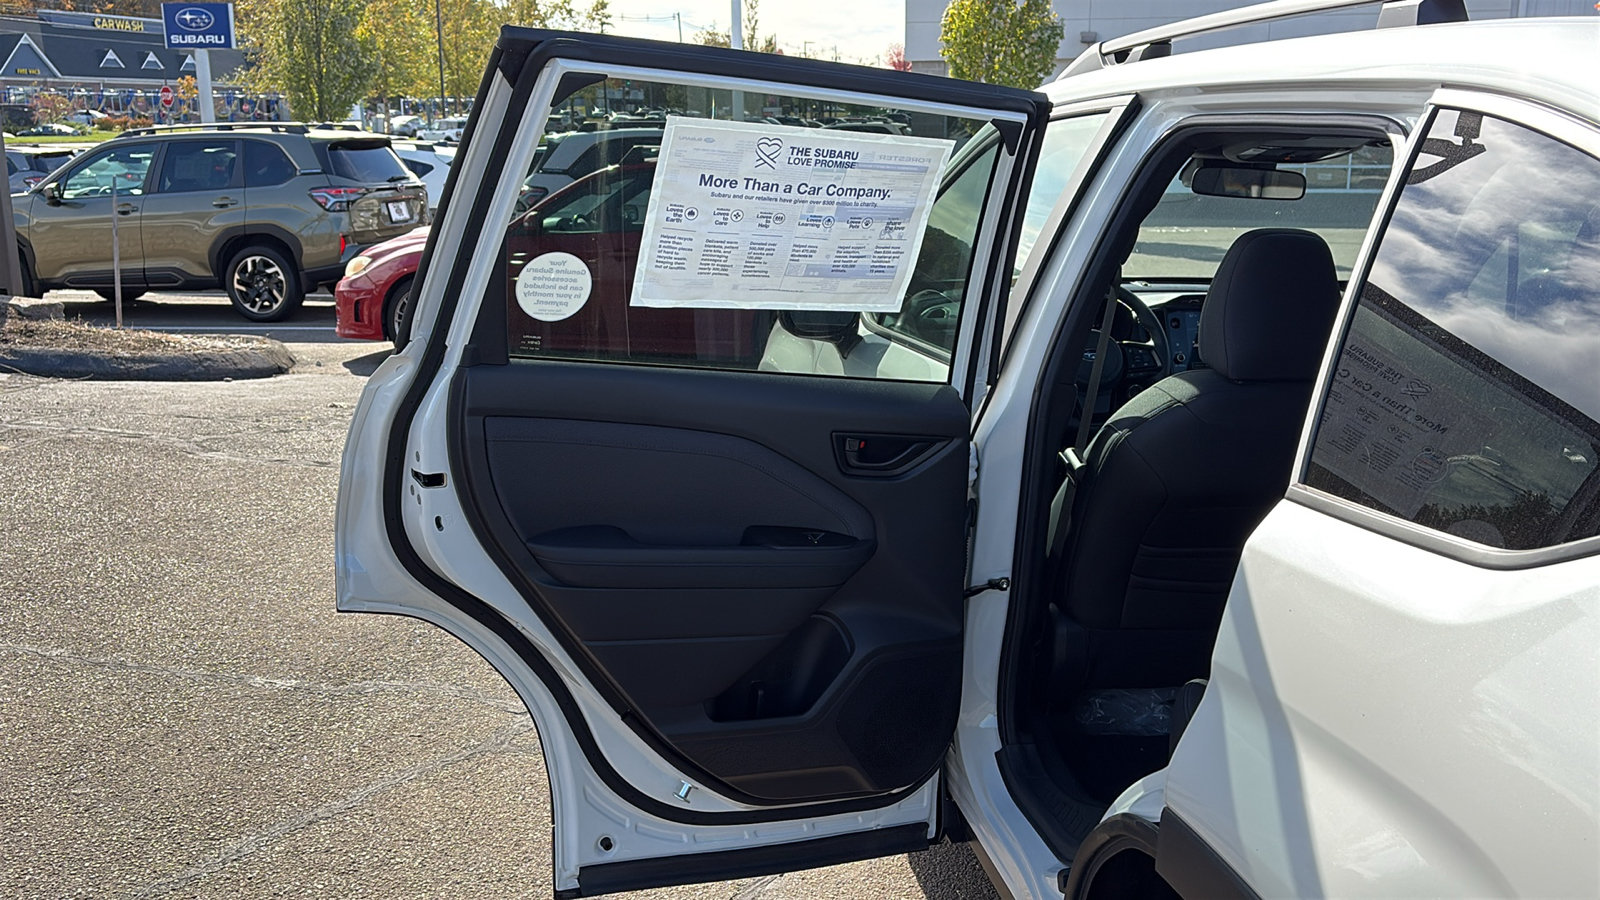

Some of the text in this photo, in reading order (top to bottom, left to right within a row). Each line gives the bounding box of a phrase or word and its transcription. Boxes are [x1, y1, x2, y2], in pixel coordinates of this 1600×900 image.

[171, 35, 225, 44] SUBARU
[790, 147, 859, 160] THE SUBARU
[787, 157, 812, 166] LOVE
[814, 159, 857, 169] PROMISE
[699, 174, 891, 200] More Than a Car Company.
